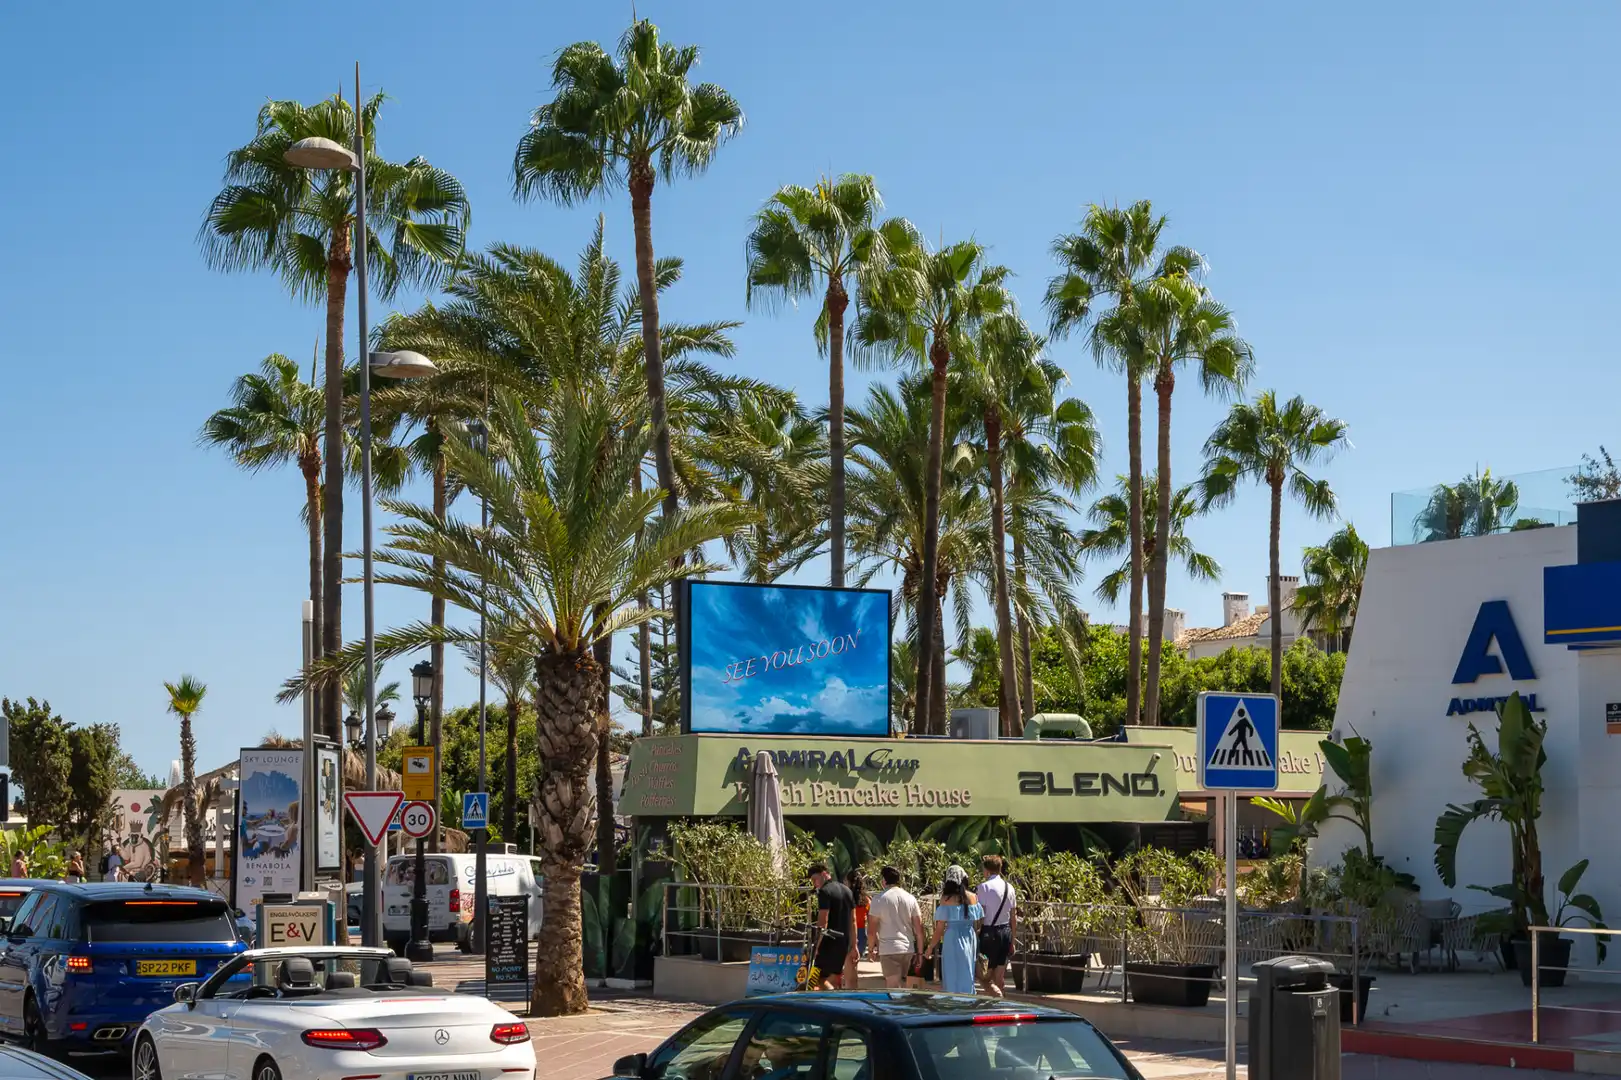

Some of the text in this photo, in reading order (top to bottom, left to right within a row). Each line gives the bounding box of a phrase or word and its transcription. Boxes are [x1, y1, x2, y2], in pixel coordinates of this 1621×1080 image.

[1451, 600, 1537, 684] A
[722, 628, 861, 684] SEE YOU SOON
[244, 755, 259, 763] SKY
[811, 781, 901, 807] Pancake
[904, 783, 972, 808] House
[408, 814, 427, 826] 30
[271, 922, 316, 942] E&V
[141, 962, 191, 973] SP22 PKF
